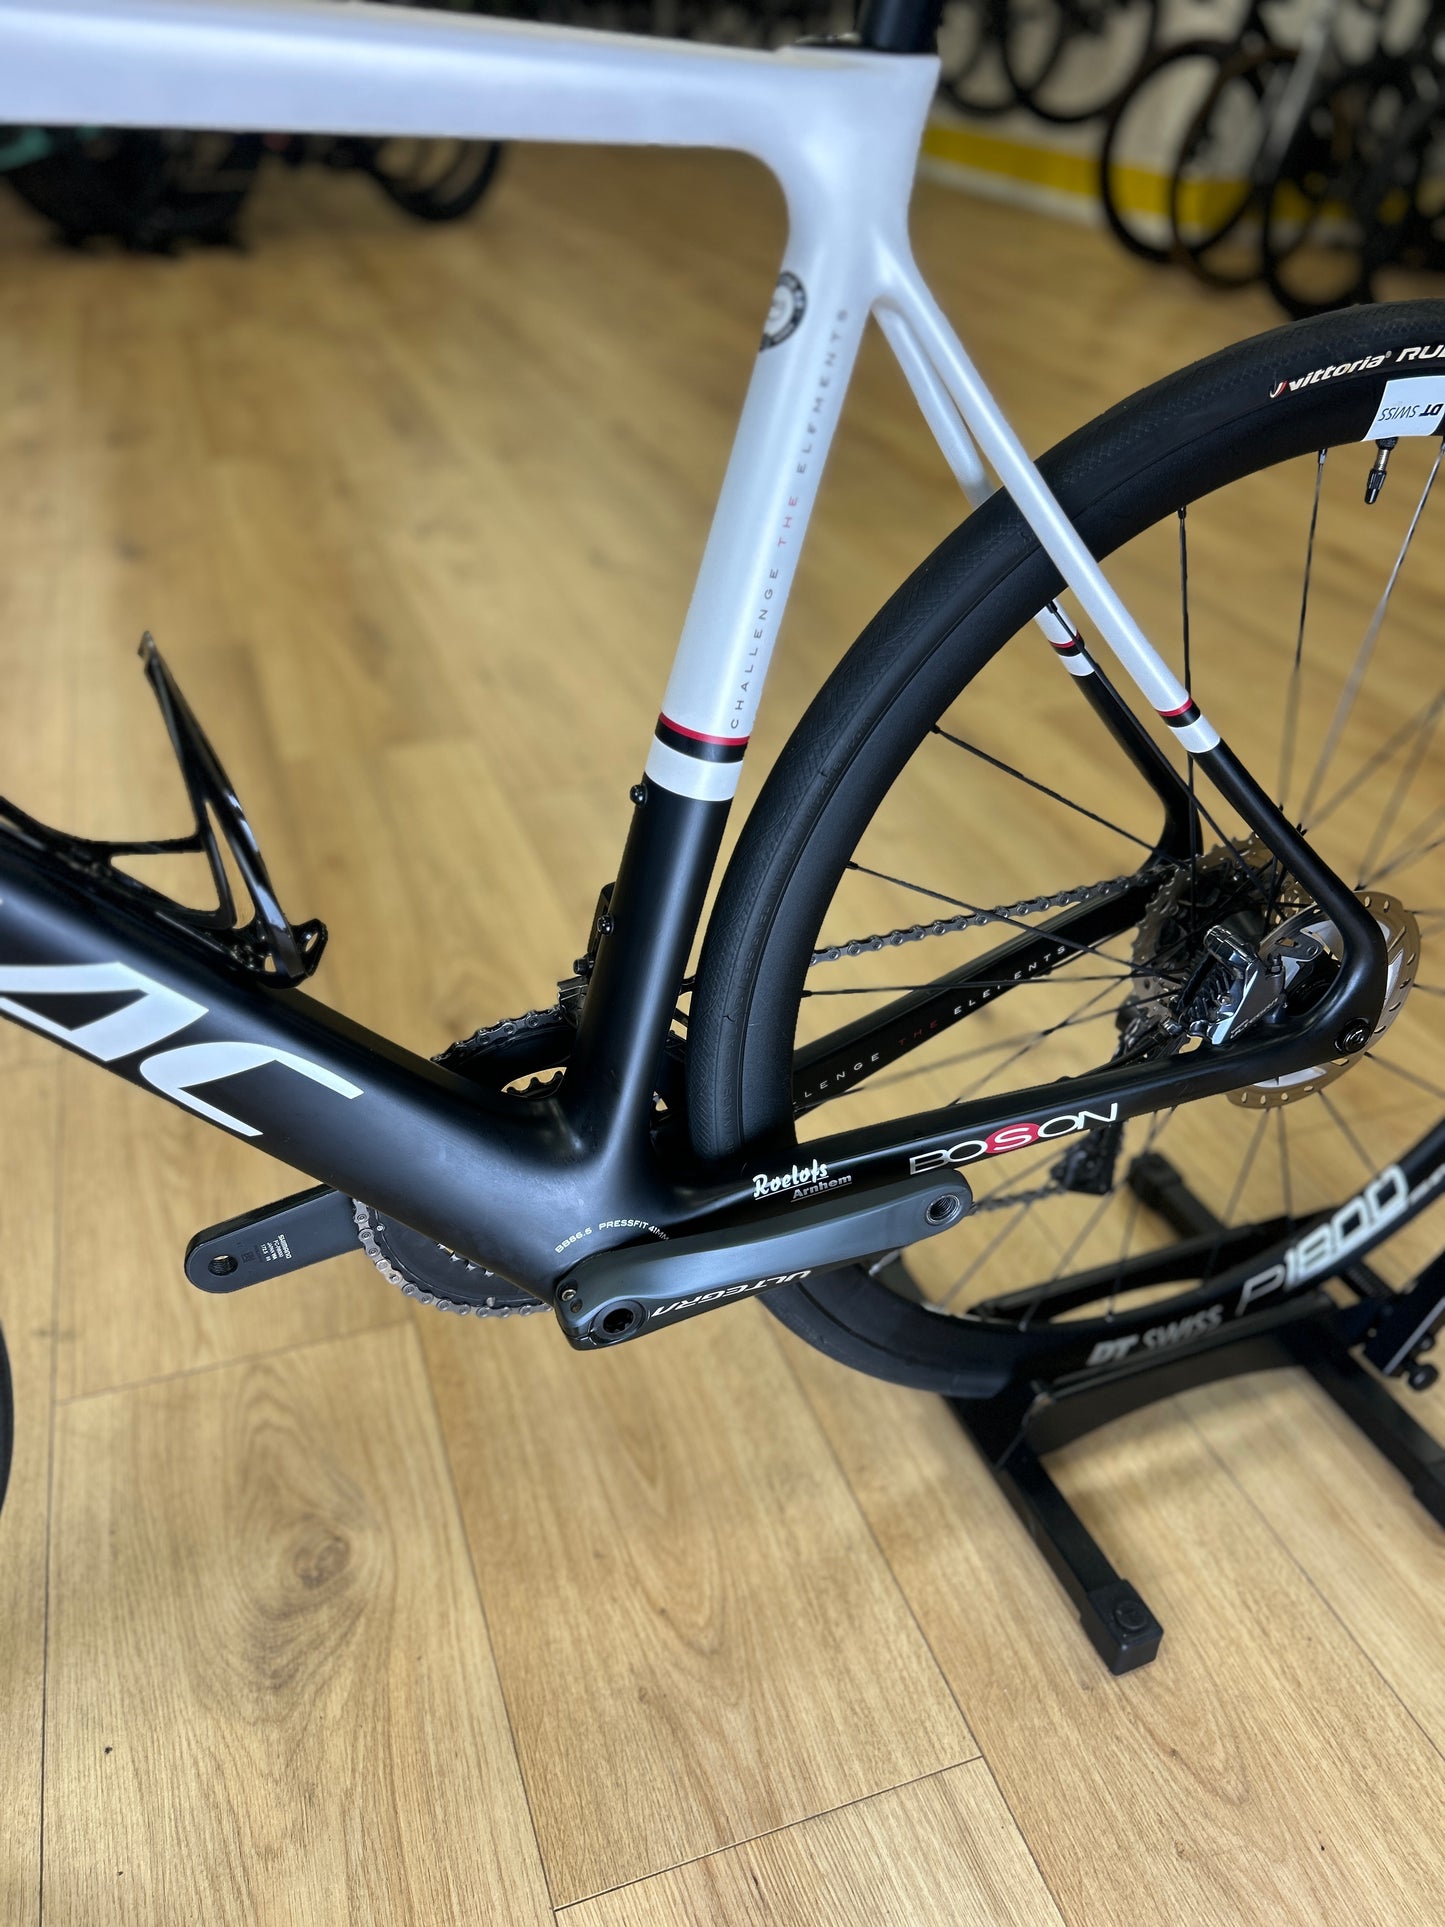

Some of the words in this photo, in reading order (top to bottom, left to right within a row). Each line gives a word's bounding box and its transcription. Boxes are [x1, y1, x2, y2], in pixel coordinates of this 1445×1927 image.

[1394, 344, 1445, 363] RU
[1377, 404, 1421, 422] SWISS
[1418, 402, 1445, 417] DT
[730, 568, 779, 730] CHALLENGE
[777, 495, 798, 547] THE
[795, 308, 848, 474] ELEMENTS
[793, 1051, 880, 1107] LENGE
[898, 1020, 938, 1046] THE
[953, 945, 1066, 1015] ELEENTS
[909, 1102, 1118, 1176] BOSON
[752, 1158, 829, 1199] Roelofs
[792, 1174, 852, 1200] Arnhem
[598, 1219, 649, 1231] PRESSFIT
[1235, 1163, 1410, 1316] P1800
[650, 1269, 812, 1318] ULTEGRA
[1086, 1333, 1140, 1367] DT
[1142, 1303, 1225, 1350] SWISS
